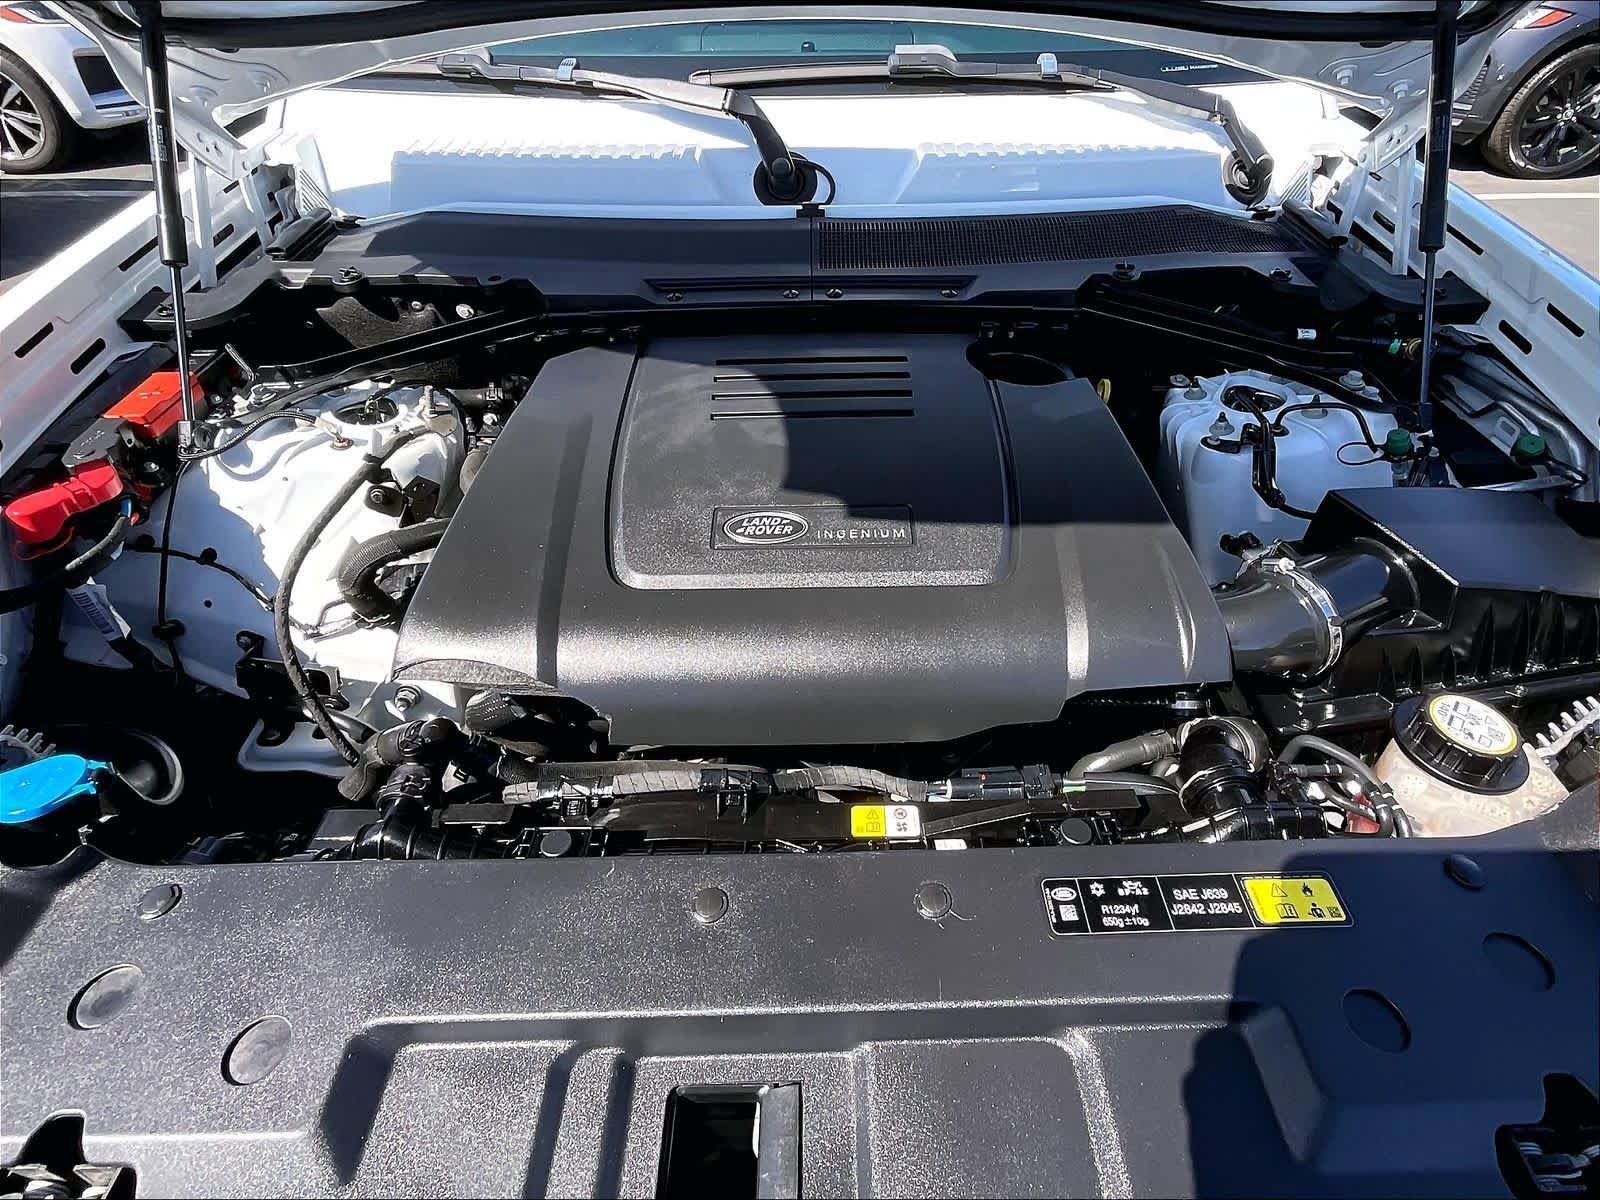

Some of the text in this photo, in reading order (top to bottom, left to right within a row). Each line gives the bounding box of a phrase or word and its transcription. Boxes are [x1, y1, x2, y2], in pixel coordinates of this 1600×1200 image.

[742, 517, 782, 526] LAND
[743, 525, 793, 536] ROVER
[817, 529, 906, 540] INGENIUM
[1173, 888, 1229, 900] SAE J639
[1101, 904, 1140, 916] R1234yf
[1171, 902, 1242, 915] J2842 J2845
